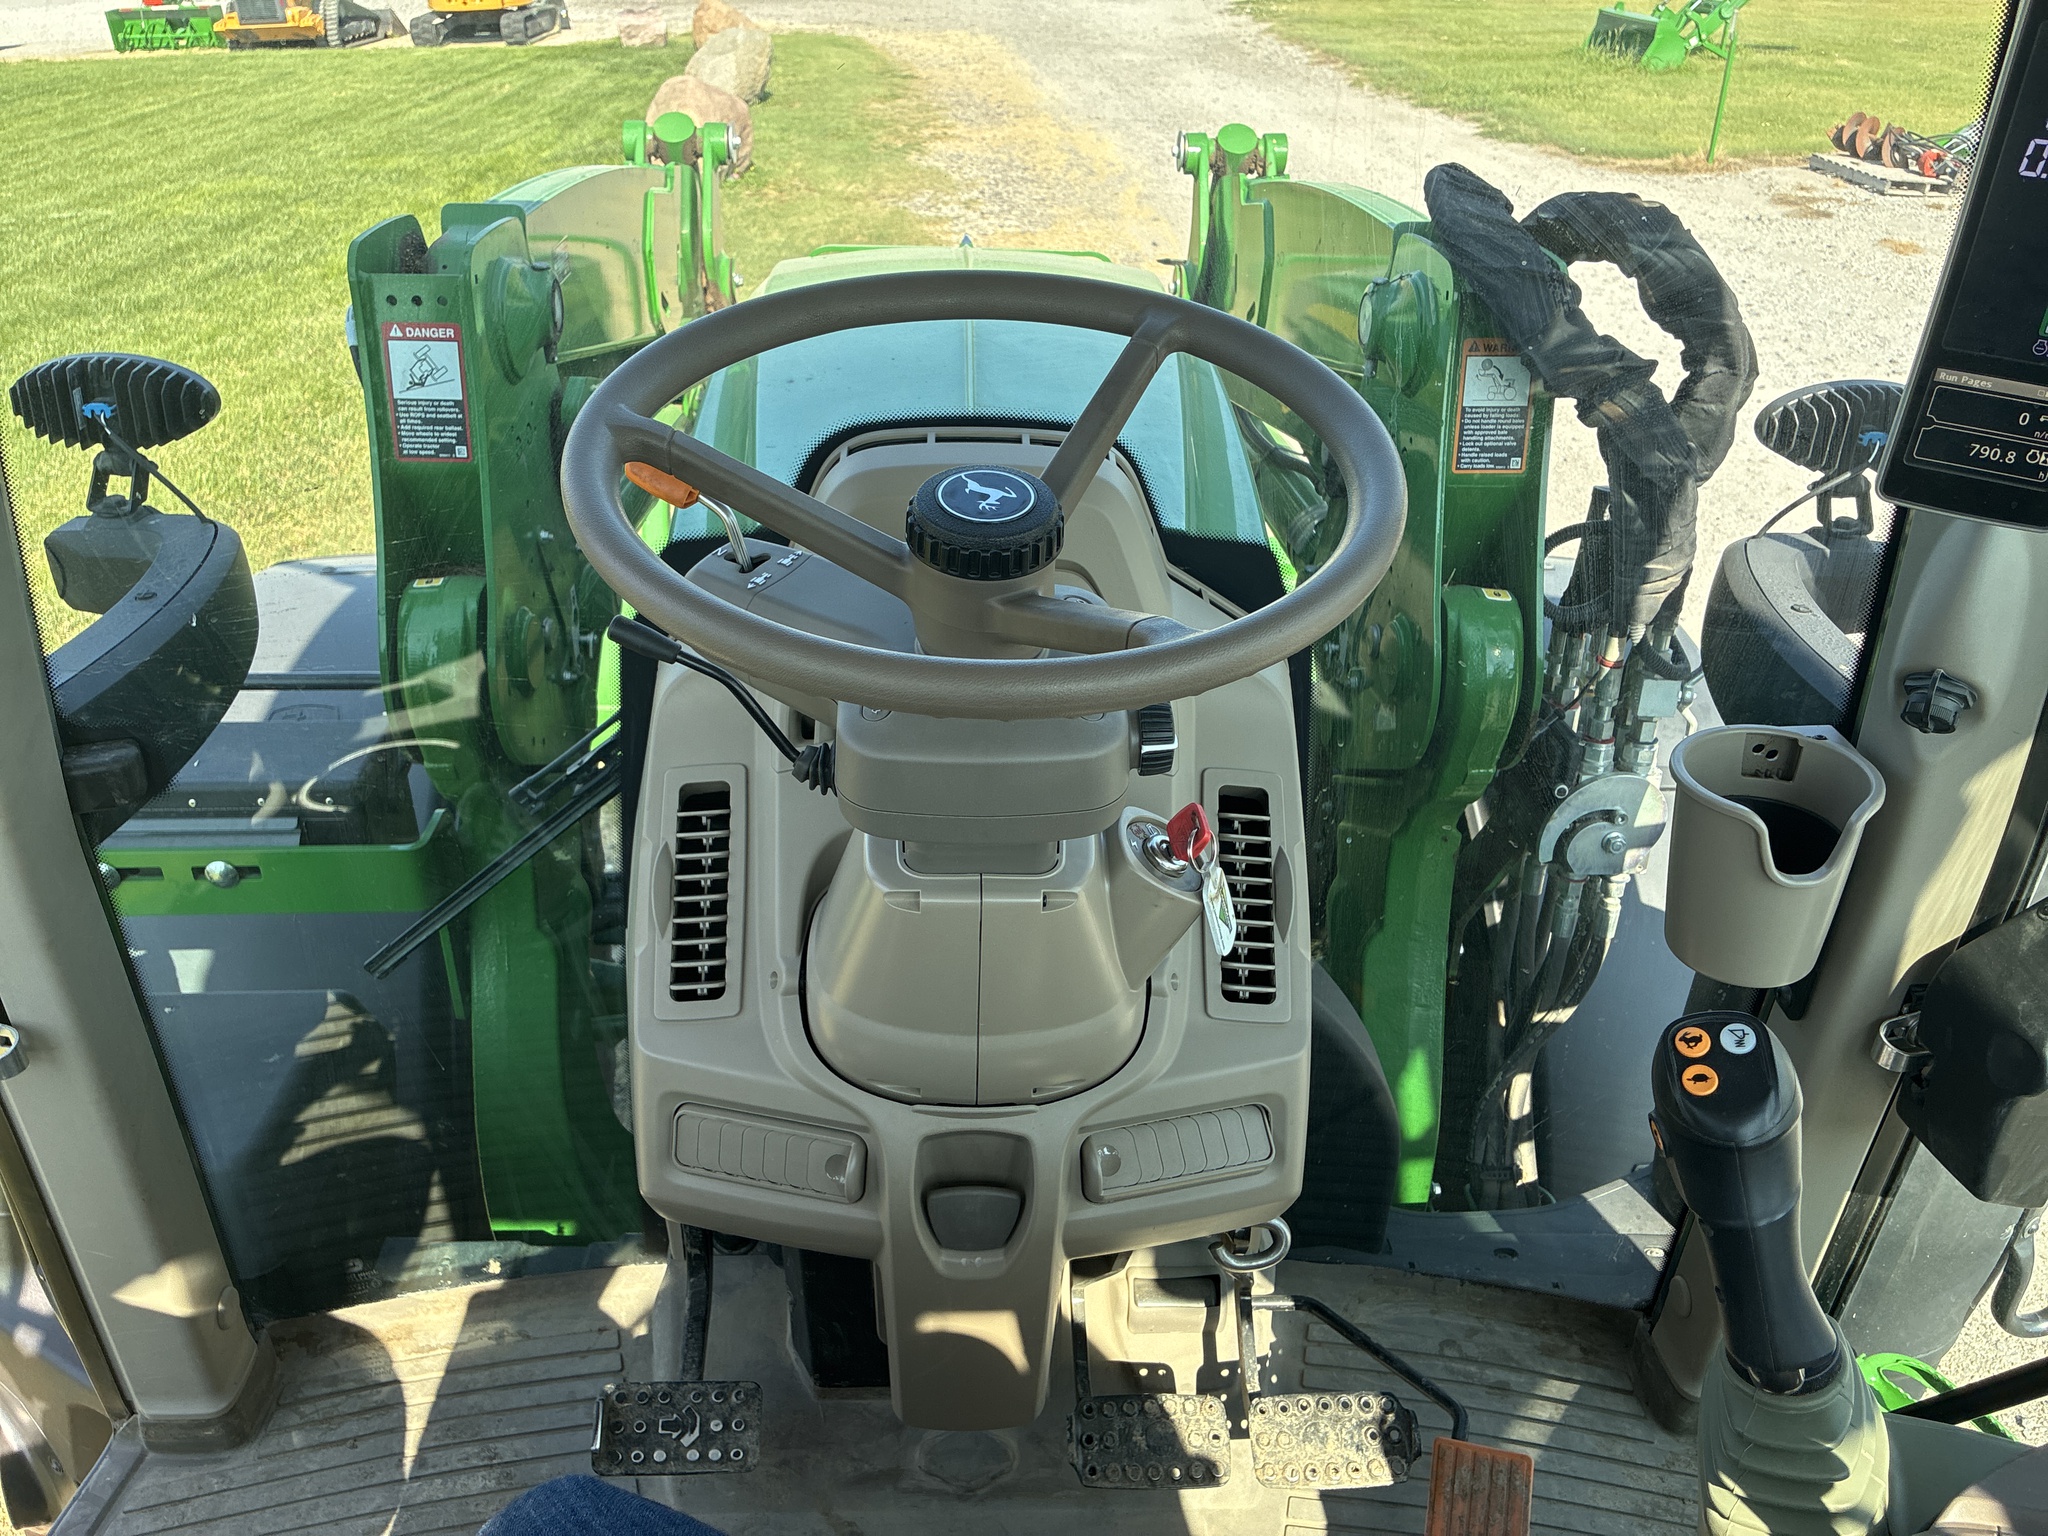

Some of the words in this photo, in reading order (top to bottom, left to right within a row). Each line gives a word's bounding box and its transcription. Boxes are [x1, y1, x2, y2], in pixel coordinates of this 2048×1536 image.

[406, 327, 455, 338] DANGER
[1940, 371, 1958, 382] Run
[1961, 375, 1993, 388] Pages
[2019, 412, 2030, 426] 0
[1969, 443, 2016, 464] 790.8
[2038, 470, 2045, 480] h
